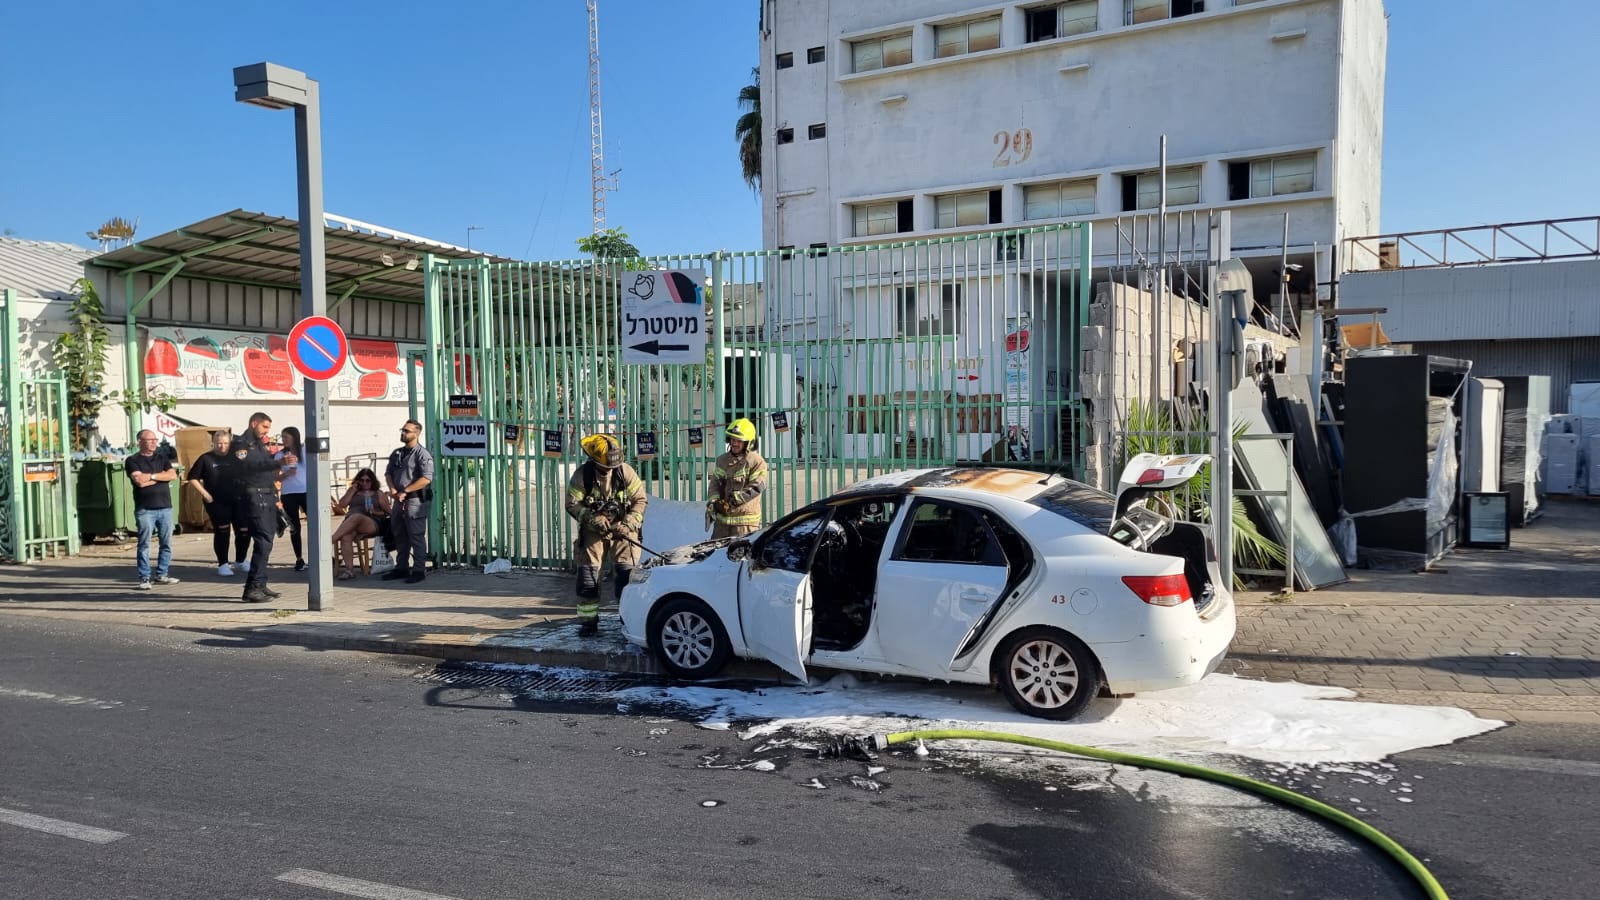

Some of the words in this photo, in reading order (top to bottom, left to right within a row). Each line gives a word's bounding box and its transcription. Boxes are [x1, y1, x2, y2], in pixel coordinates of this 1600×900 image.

[992, 128, 1033, 168] 29
[626, 313, 698, 335] מיסטרל
[183, 359, 221, 370] MISTRAL
[187, 374, 221, 386] HOME
[443, 422, 485, 435] מיסטרל
[1051, 595, 1066, 605] 43
